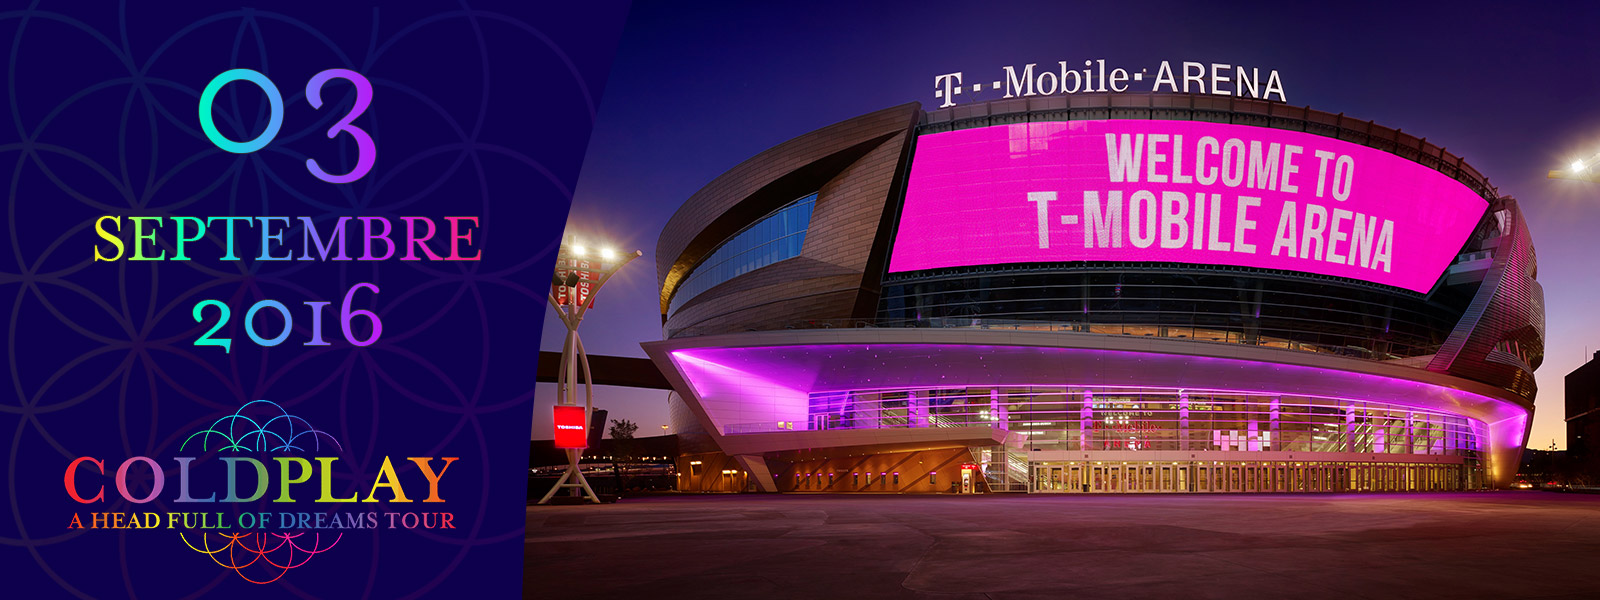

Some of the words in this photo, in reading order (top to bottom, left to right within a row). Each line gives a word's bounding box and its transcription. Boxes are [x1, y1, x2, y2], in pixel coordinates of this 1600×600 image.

[1152, 60, 1288, 102] ARENA
[1105, 133, 1304, 194] WELCOME
[1314, 150, 1355, 202] TO
[1027, 189, 1262, 255] T-MOBILE
[1270, 200, 1395, 273] ARENA
